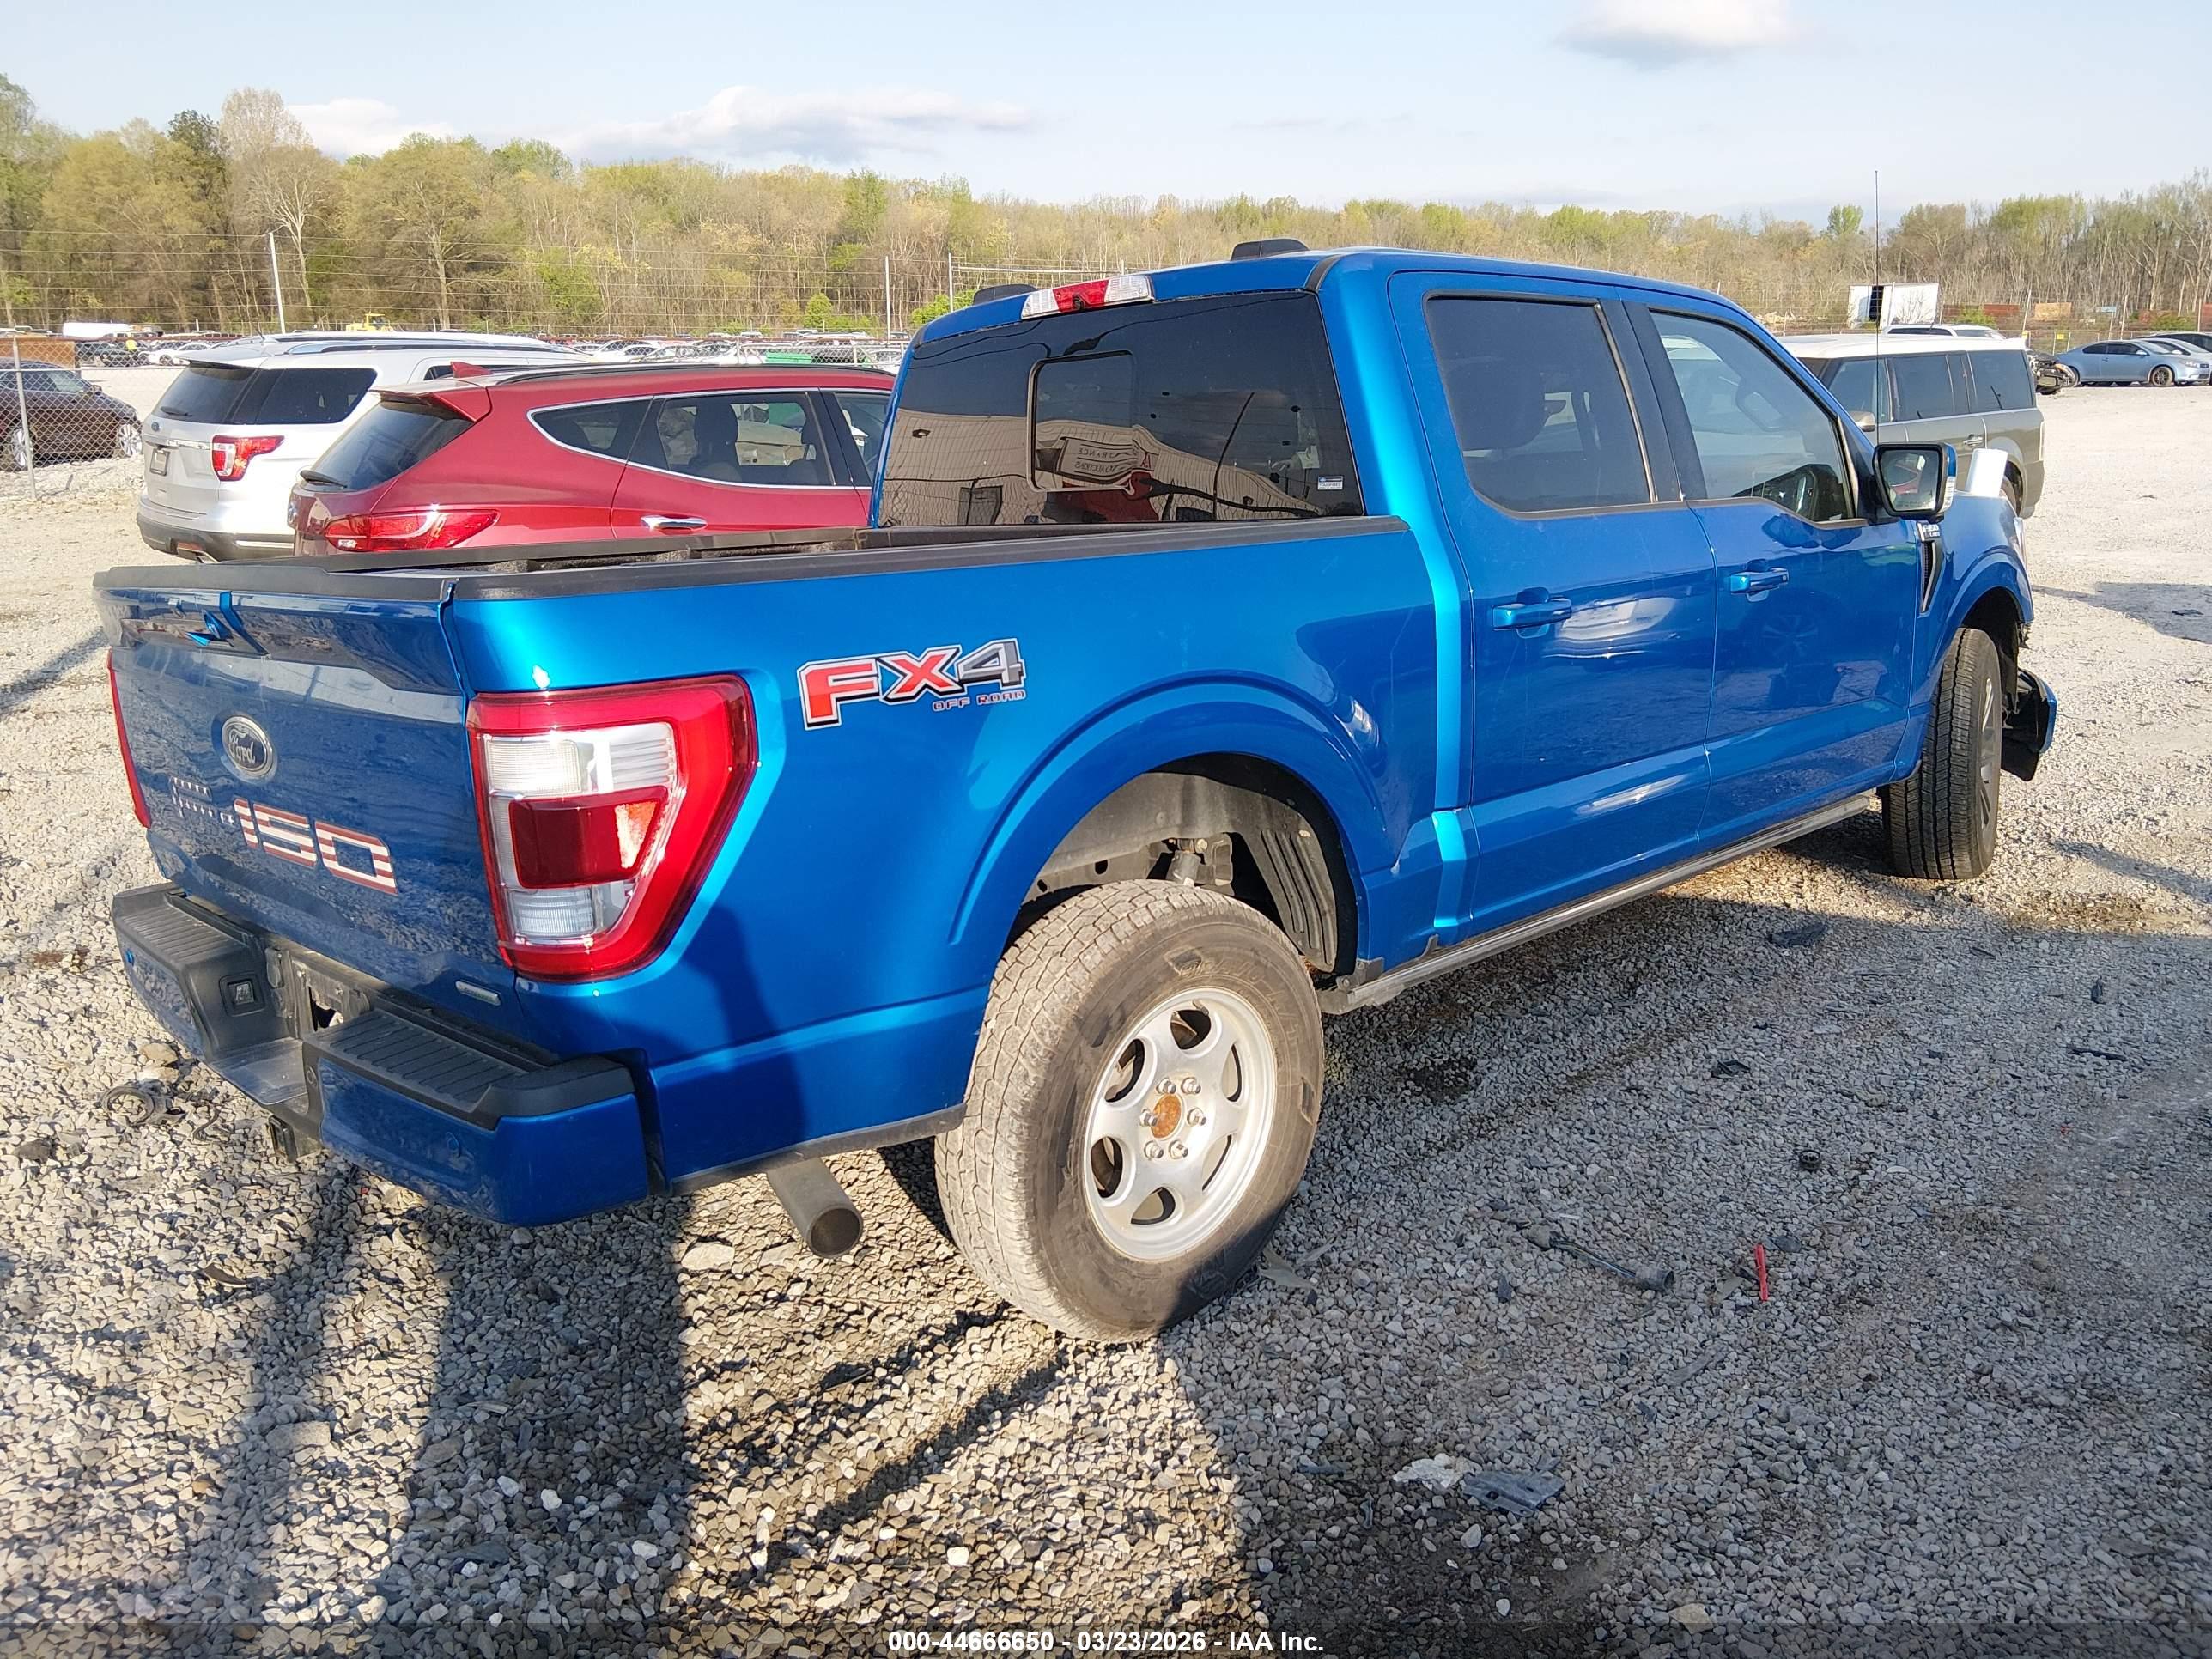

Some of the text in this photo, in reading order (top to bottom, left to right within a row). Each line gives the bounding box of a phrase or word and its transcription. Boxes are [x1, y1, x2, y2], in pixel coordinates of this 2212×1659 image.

[797, 637, 1026, 731] FX4
[933, 690, 1026, 712] OFF ROAD
[228, 726, 256, 764] Ford
